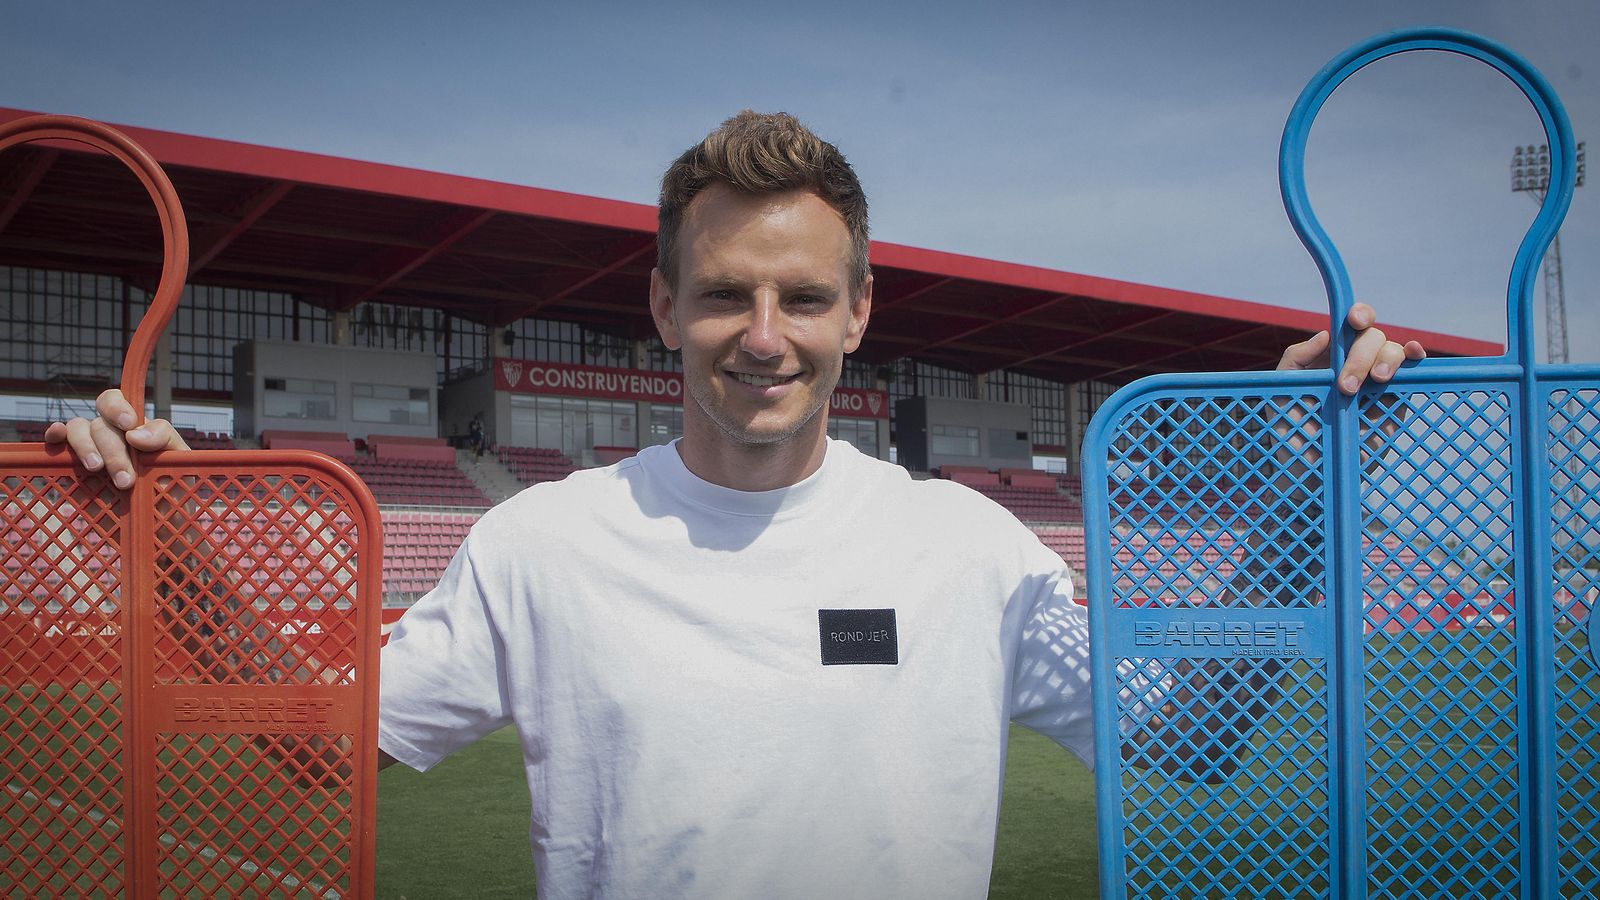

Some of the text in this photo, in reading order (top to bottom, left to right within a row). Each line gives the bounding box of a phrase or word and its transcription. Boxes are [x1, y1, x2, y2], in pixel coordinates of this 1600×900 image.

[529, 367, 863, 411] CONSTRUYENDO URO
[1135, 621, 1305, 646] BARRET
[175, 697, 333, 722] BARRET
